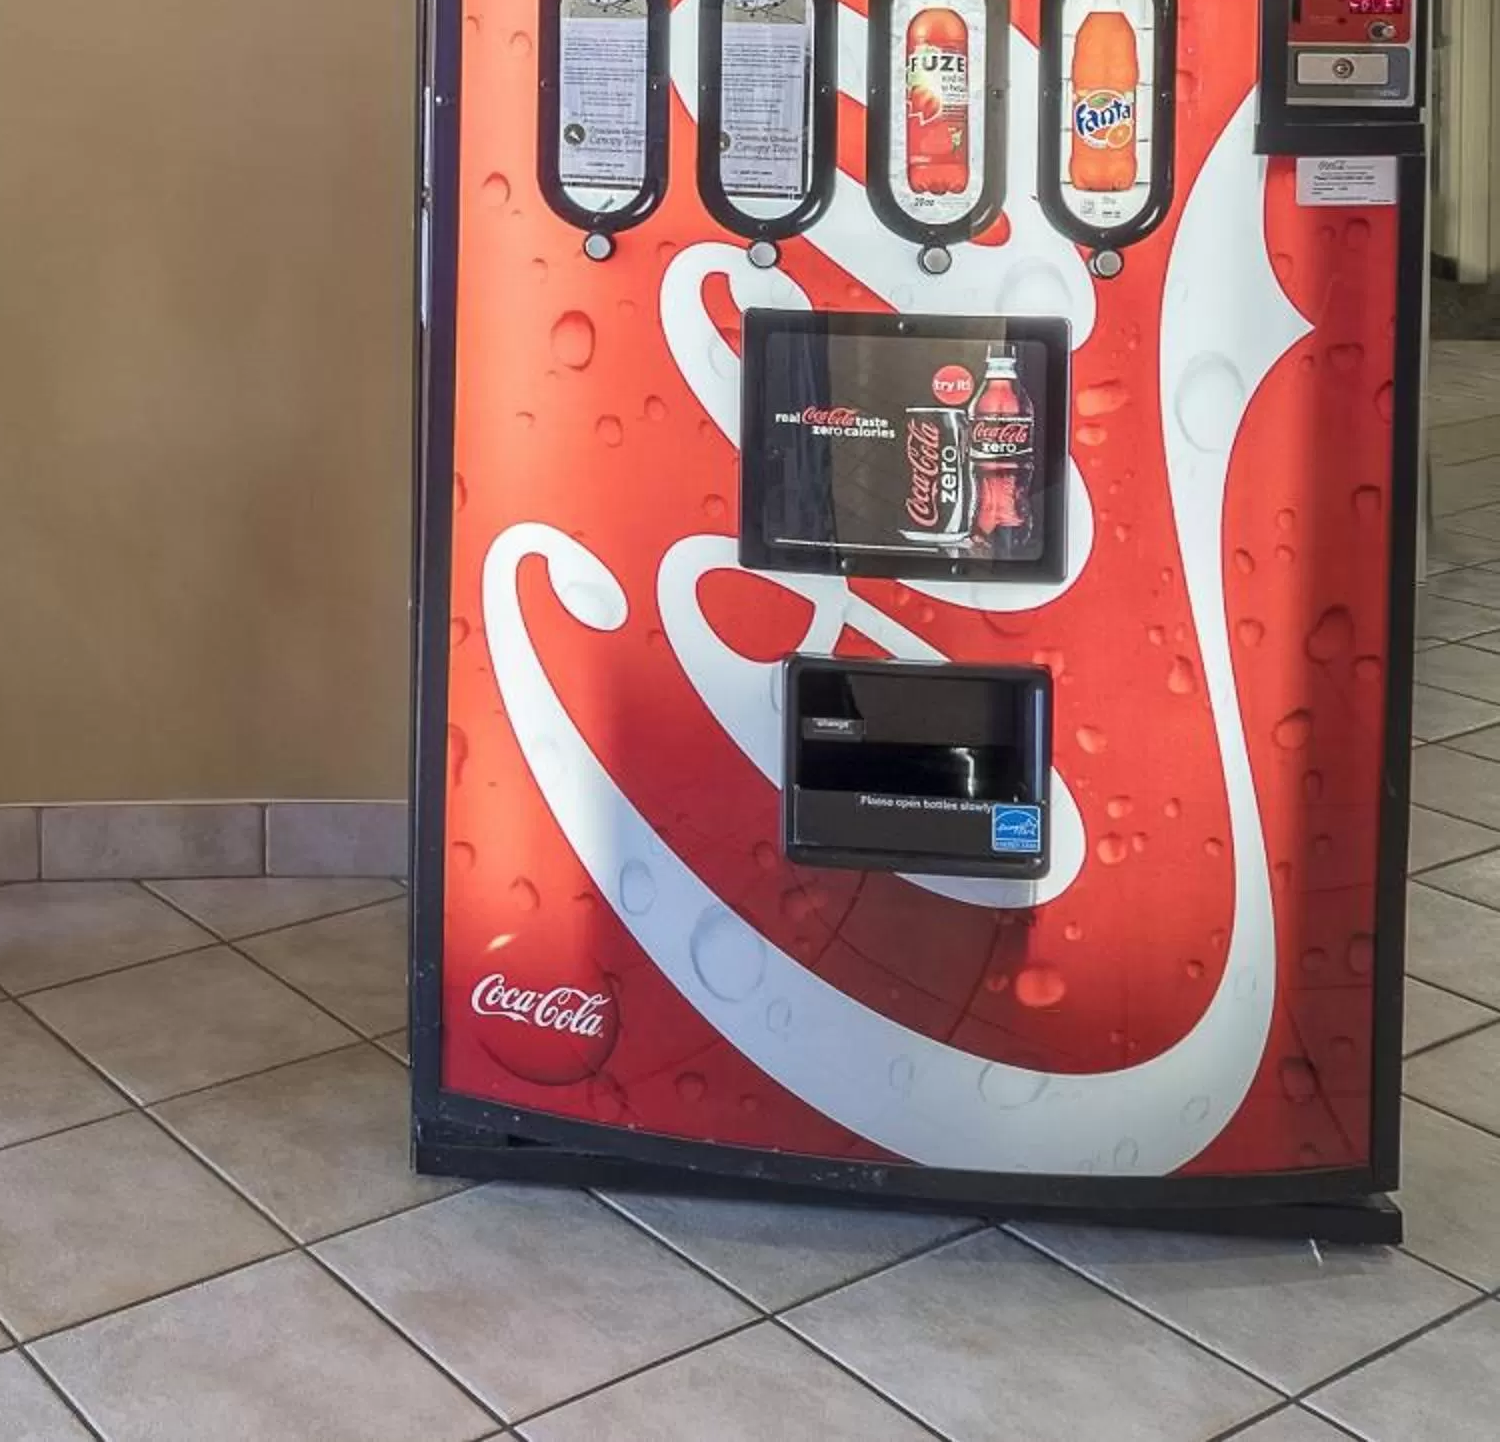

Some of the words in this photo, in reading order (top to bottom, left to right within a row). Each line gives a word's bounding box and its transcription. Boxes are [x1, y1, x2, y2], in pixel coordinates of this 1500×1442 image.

[910, 55, 965, 73] FUZE
[933, 379, 954, 393] try
[775, 411, 801, 424] real
[855, 416, 889, 428] taste
[812, 425, 843, 436] zero
[844, 426, 896, 439] calories
[981, 443, 1017, 454] zero
[941, 446, 958, 503] zero
[860, 795, 894, 807] Please
[896, 799, 922, 809] open
[923, 800, 958, 811] bottles
[471, 974, 611, 1038] Coca-Cola
